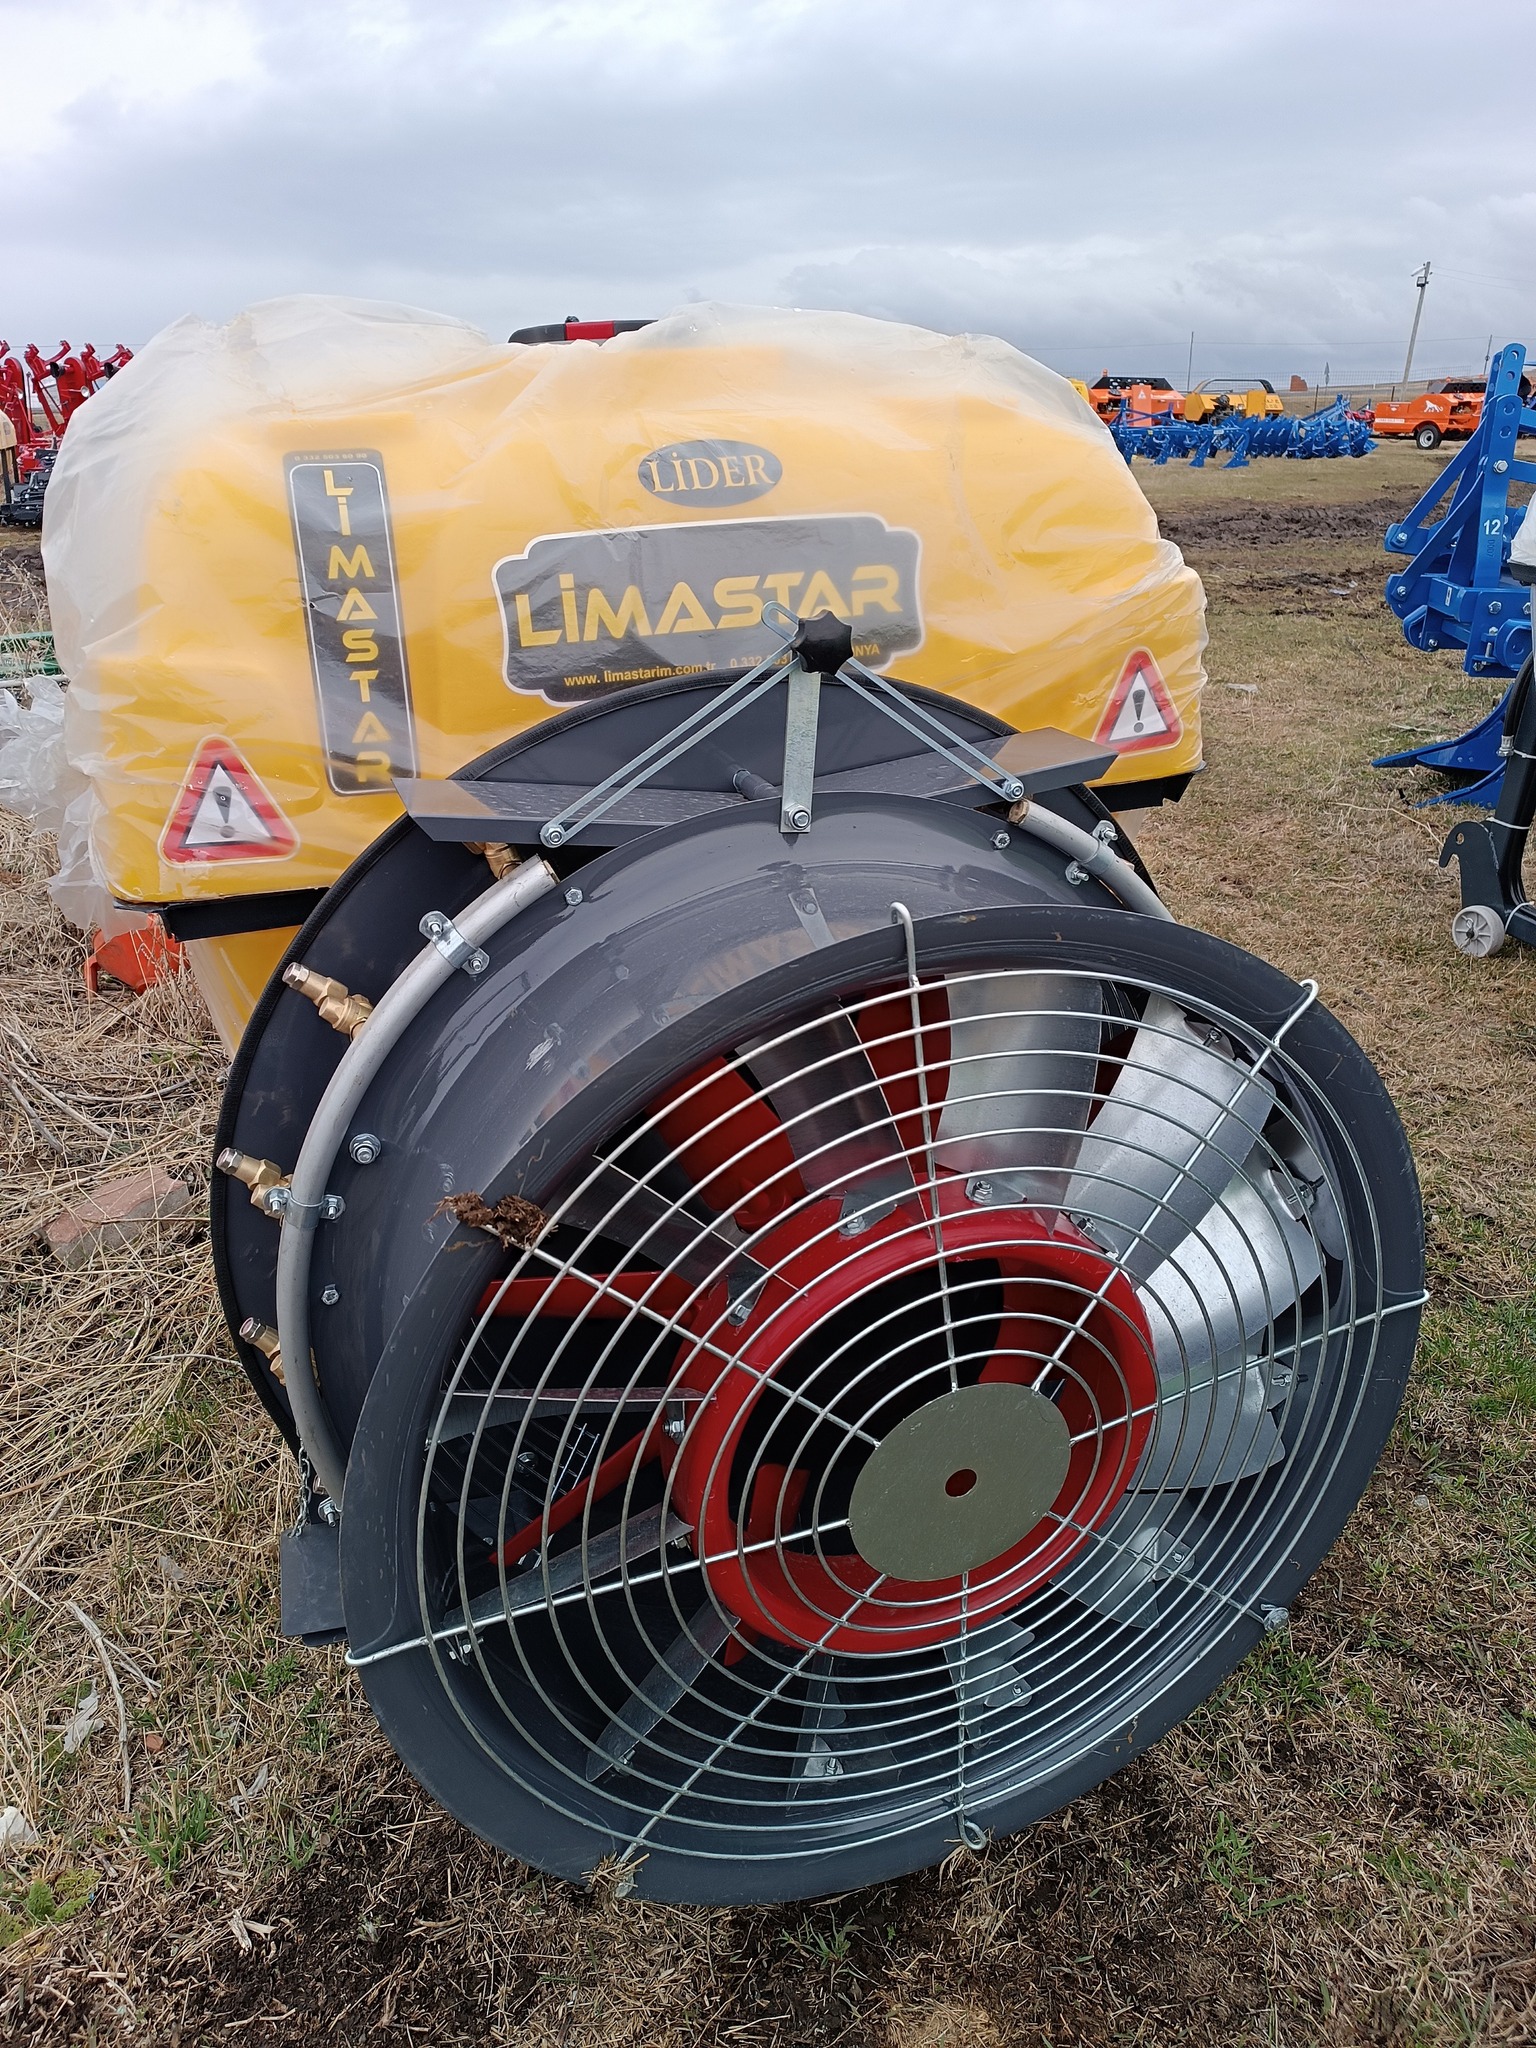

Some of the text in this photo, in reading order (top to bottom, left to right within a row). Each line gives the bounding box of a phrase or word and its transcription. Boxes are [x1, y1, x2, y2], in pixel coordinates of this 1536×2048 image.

[646, 452, 776, 493] LİDER
[1483, 519, 1501, 535] 12
[564, 674, 600, 687] www.
